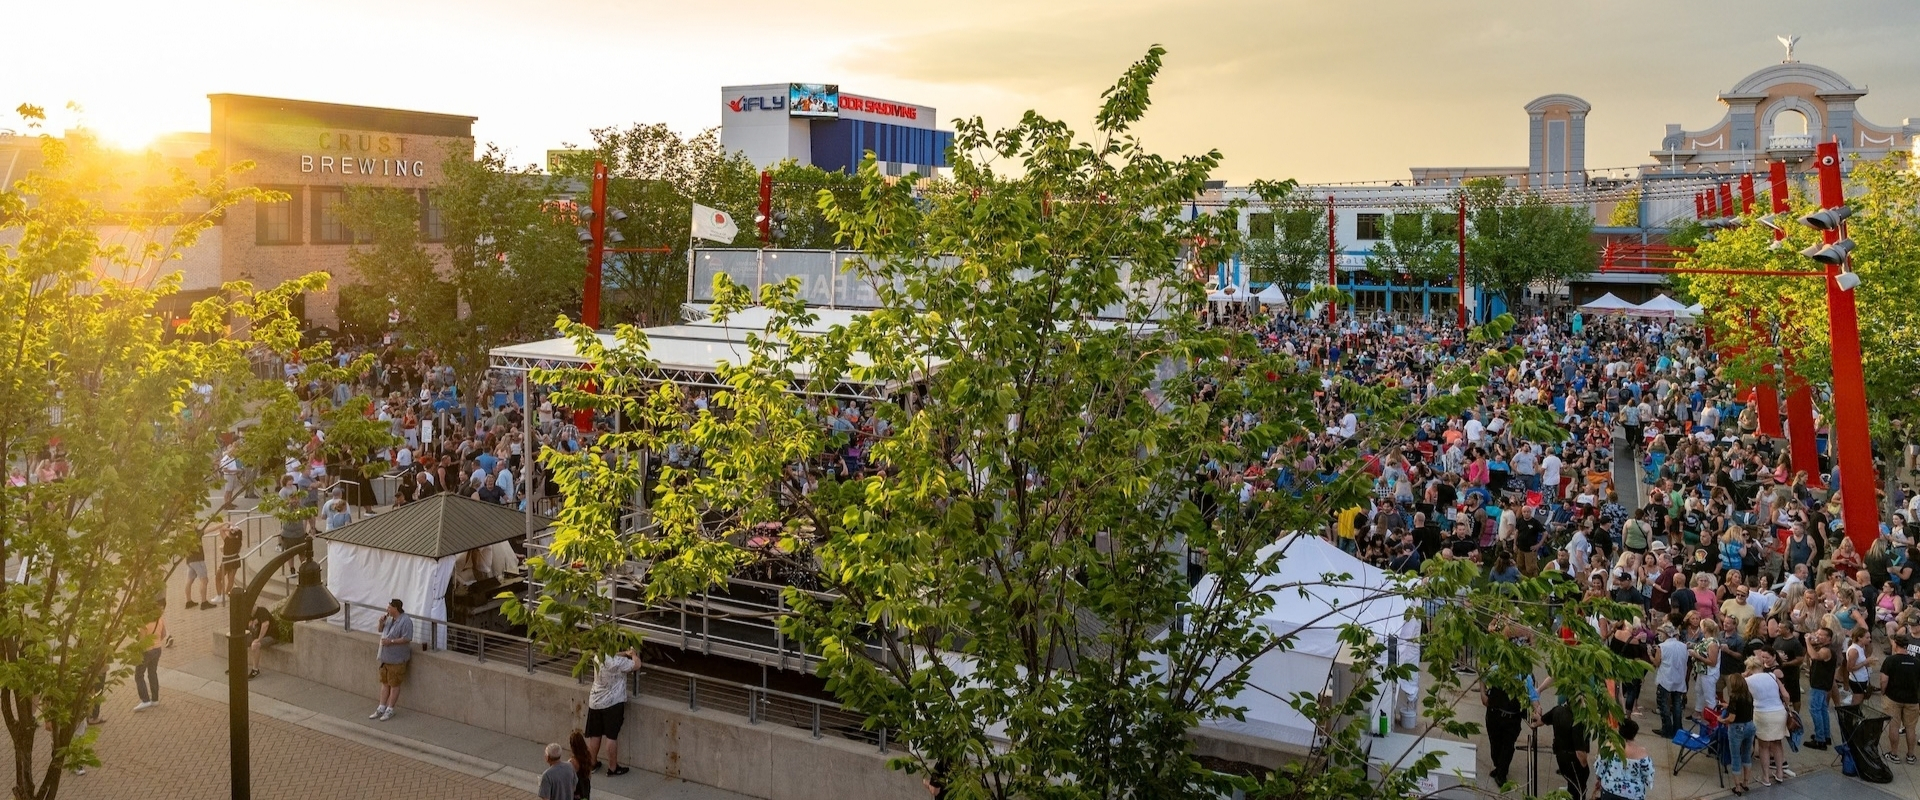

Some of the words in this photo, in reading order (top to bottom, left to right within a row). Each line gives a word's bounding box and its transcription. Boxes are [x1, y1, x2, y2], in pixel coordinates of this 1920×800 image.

[742, 95, 785, 112] iFLY
[865, 99, 917, 120] SKYDIVING
[318, 131, 408, 154] CRUST
[300, 154, 424, 178] BREWING
